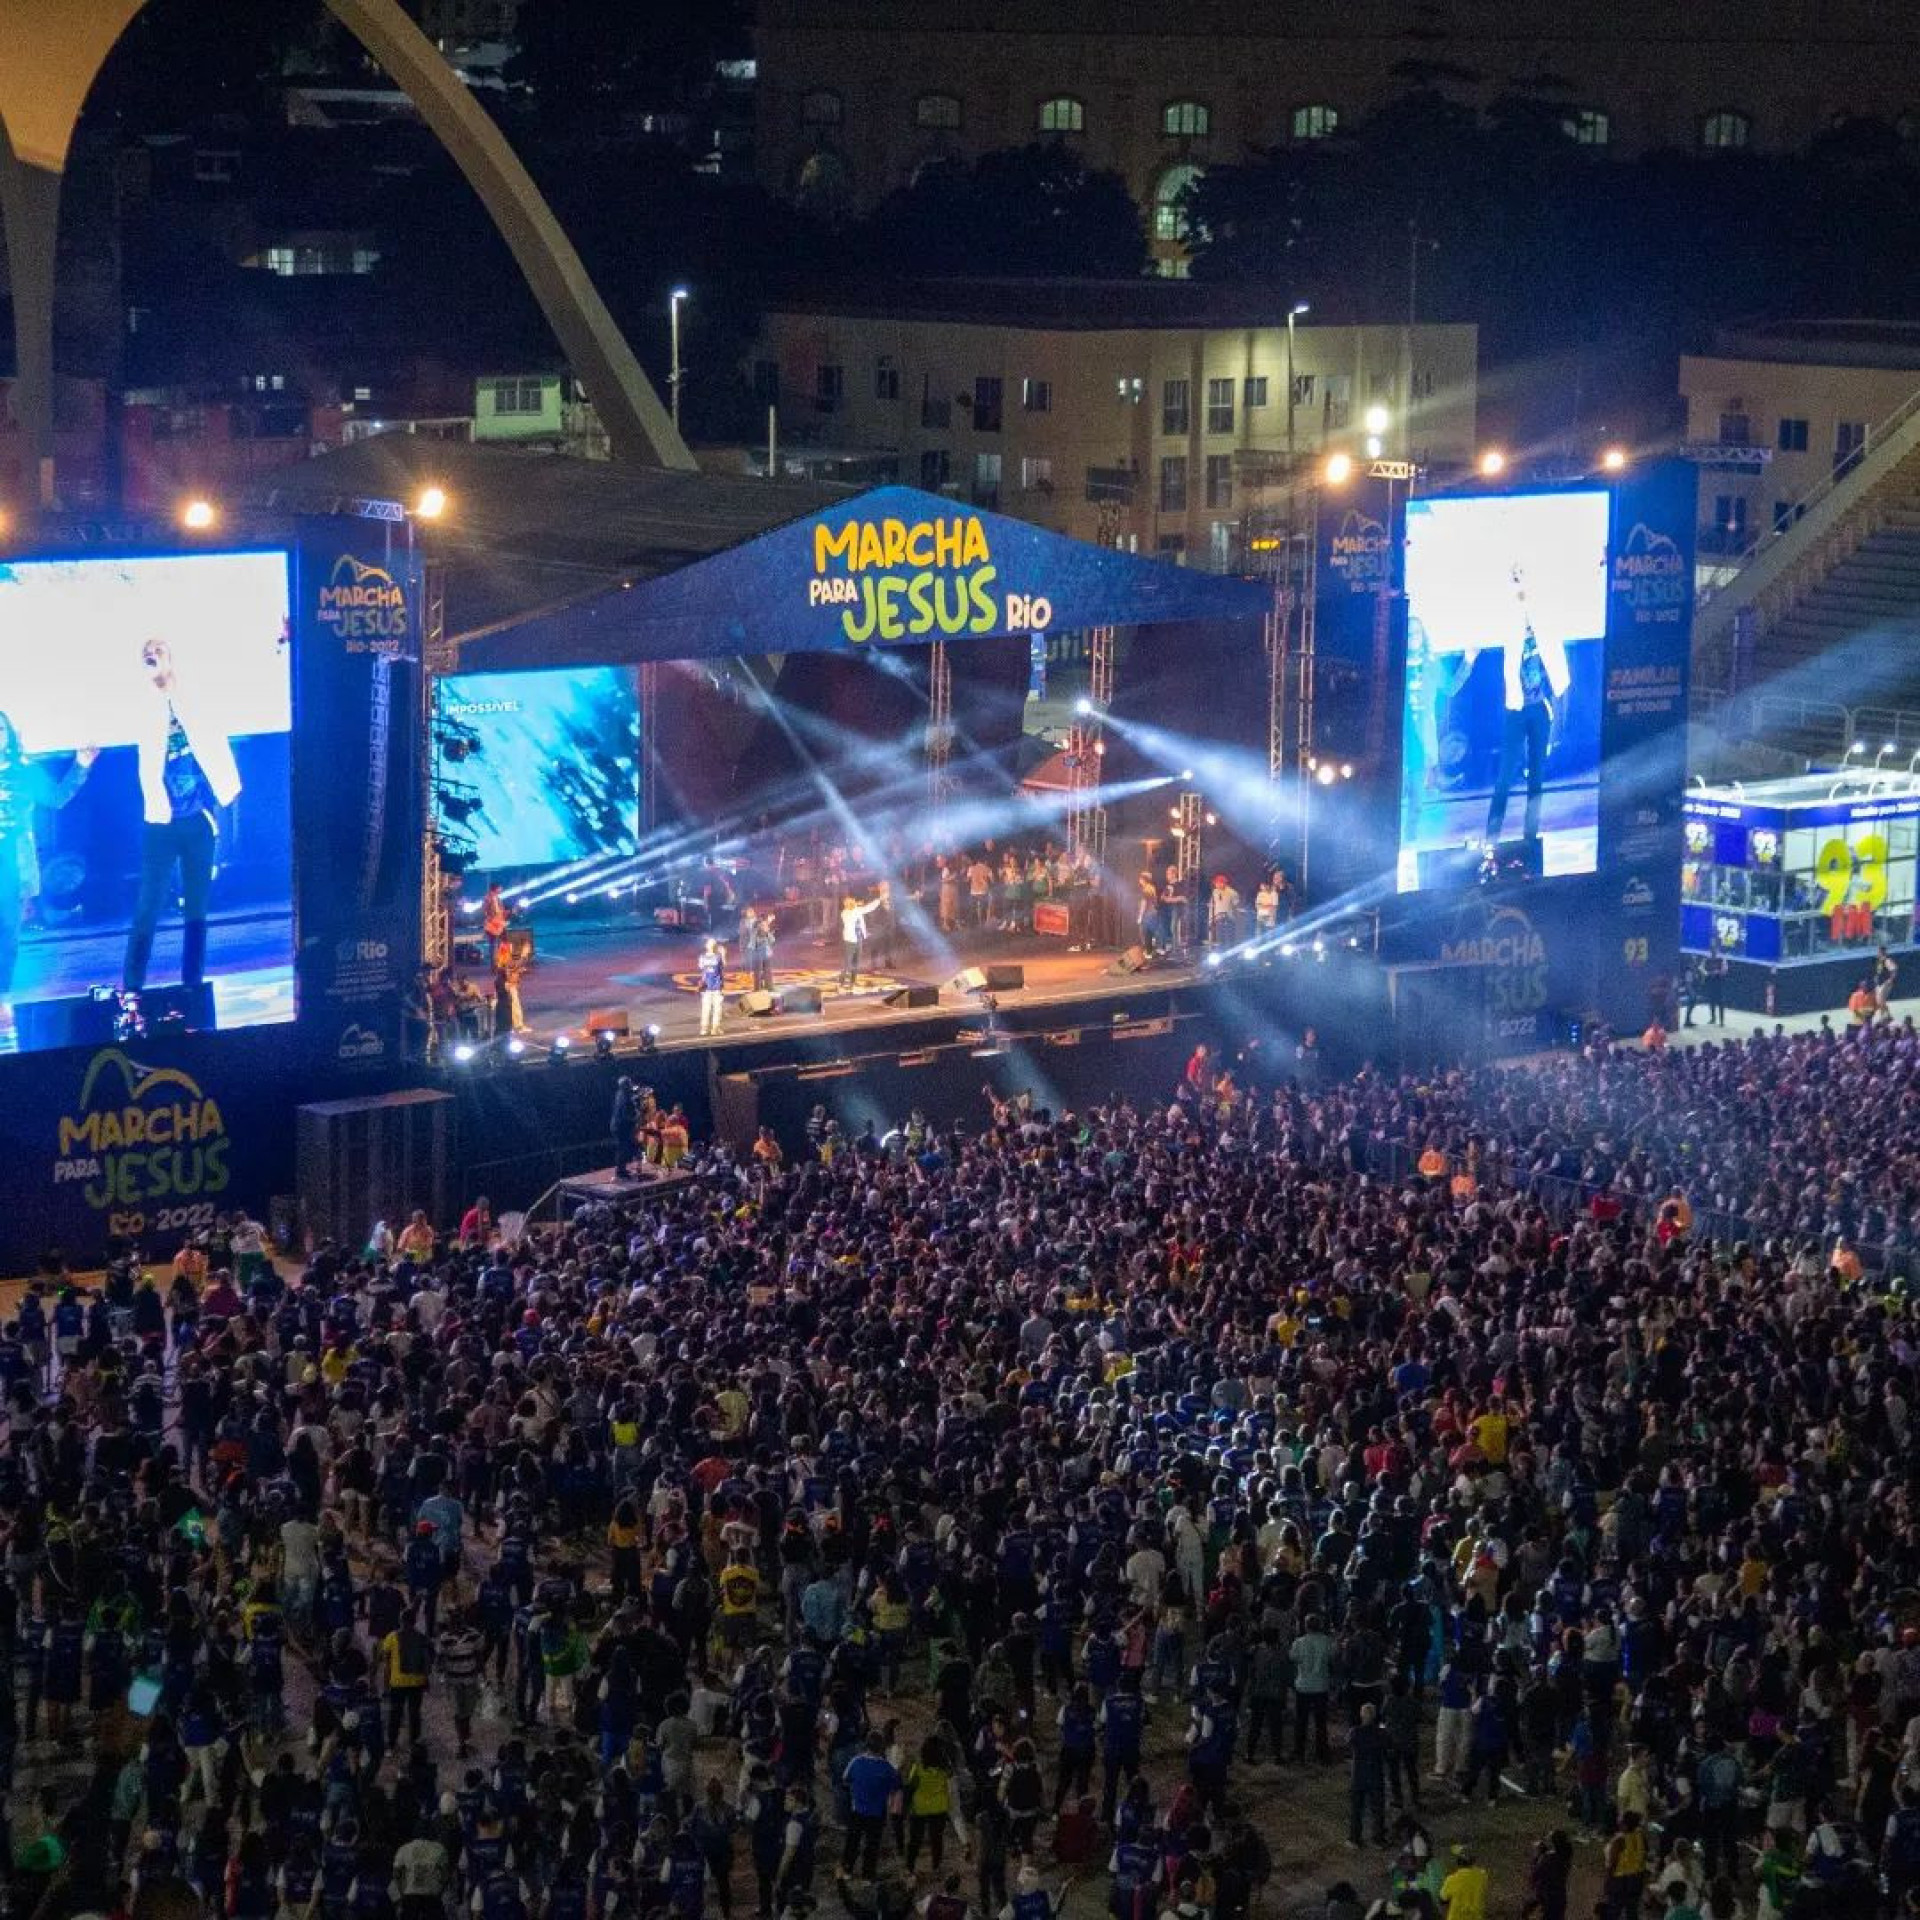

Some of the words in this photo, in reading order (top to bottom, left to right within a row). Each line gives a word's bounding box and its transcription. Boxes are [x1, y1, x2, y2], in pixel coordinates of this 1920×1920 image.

[814, 516, 989, 573] MARCHA
[320, 584, 403, 608] MARCHA
[332, 606, 407, 638] JESUS
[809, 578, 859, 606] PARA
[842, 565, 998, 642] JESUS
[1817, 833, 1889, 917] 93
[1440, 933, 1545, 969] MARCHA
[59, 1099, 223, 1156] MARCHA
[54, 1158, 100, 1184] PARA
[85, 1138, 231, 1209] JESUS
[155, 1202, 216, 1230] 2022
